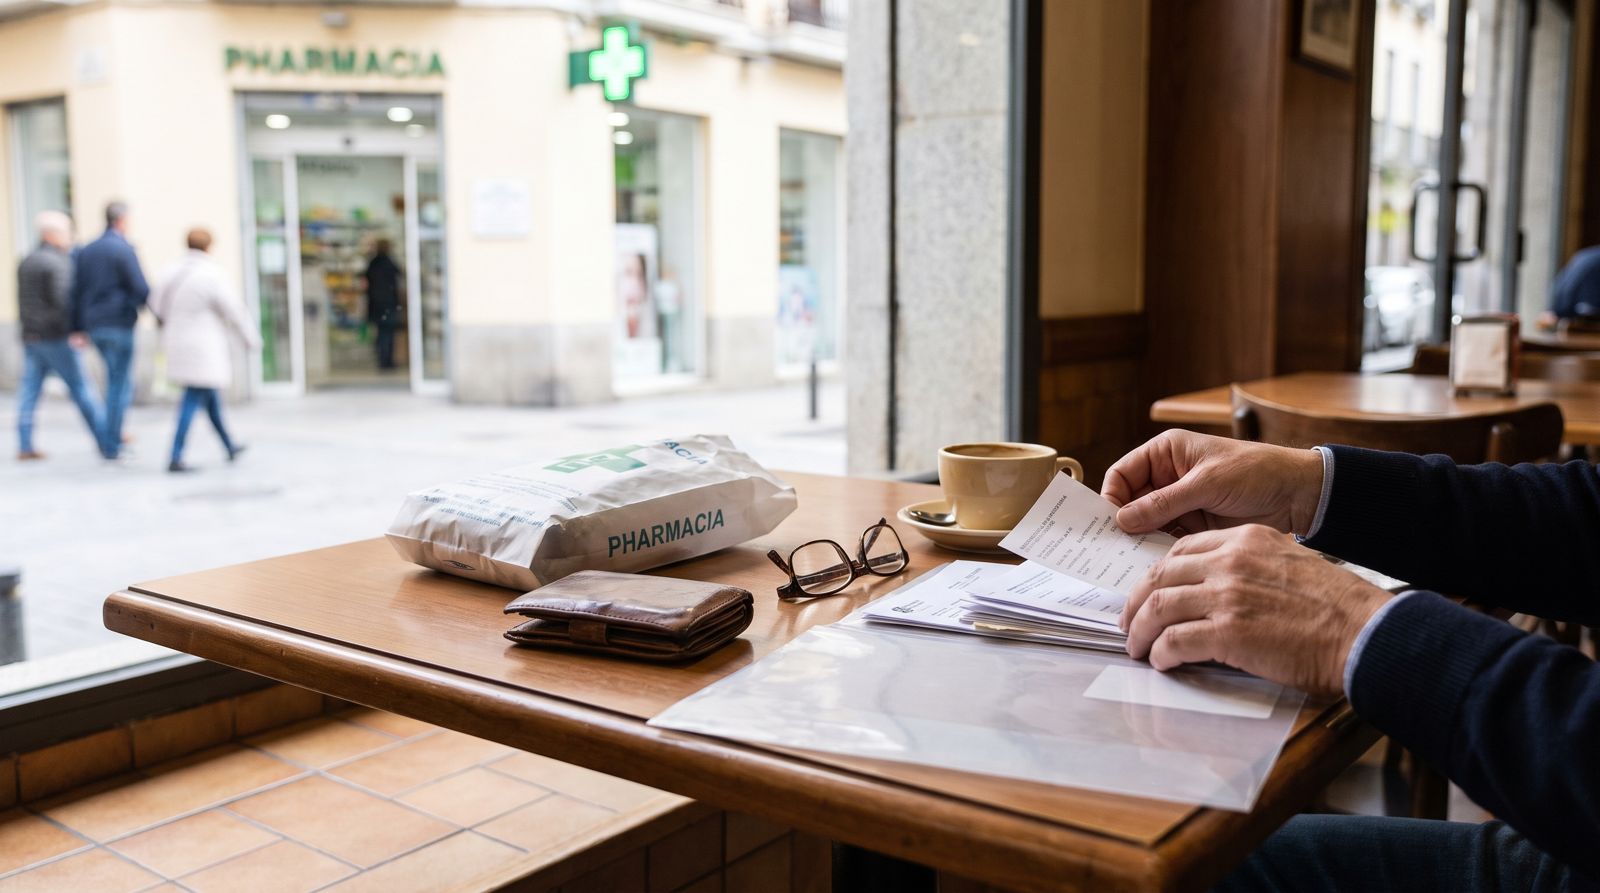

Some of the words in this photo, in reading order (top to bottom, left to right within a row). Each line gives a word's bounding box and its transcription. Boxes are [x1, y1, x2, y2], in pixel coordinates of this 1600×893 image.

[224, 46, 446, 79] PHARMACIA
[663, 438, 709, 465] ACIA
[608, 508, 724, 558] PHARMACIA
